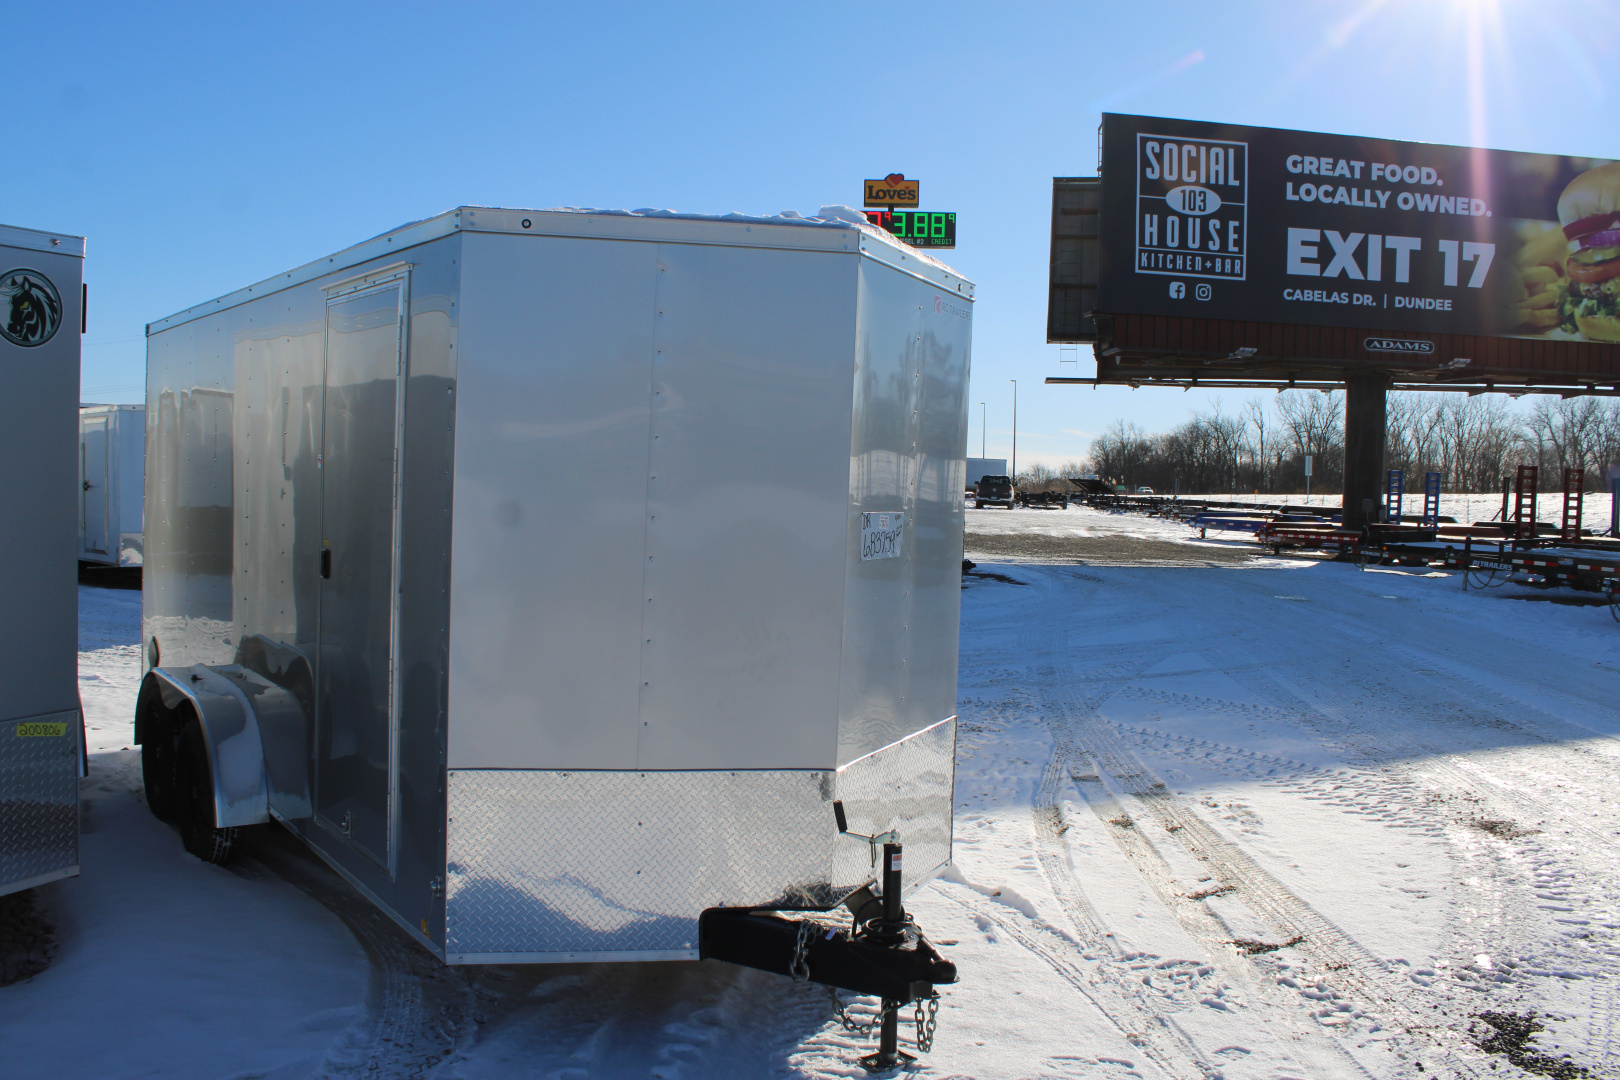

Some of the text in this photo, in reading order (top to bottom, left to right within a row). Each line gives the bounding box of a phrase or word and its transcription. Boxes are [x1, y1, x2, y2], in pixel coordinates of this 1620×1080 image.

[1145, 141, 1240, 186] SOCIAL
[1286, 154, 1444, 186] GREAT FOOD.
[1180, 189, 1207, 212] 103
[1286, 181, 1493, 218] LOCALLY OWNED.
[1144, 214, 1240, 252] HOUSE
[1286, 227, 1496, 288] EXIT 17
[1283, 288, 1452, 311] CABELAS DR. DUNDEE
[1370, 340, 1430, 350] ADAMS
[20, 724, 60, 736] 200806
